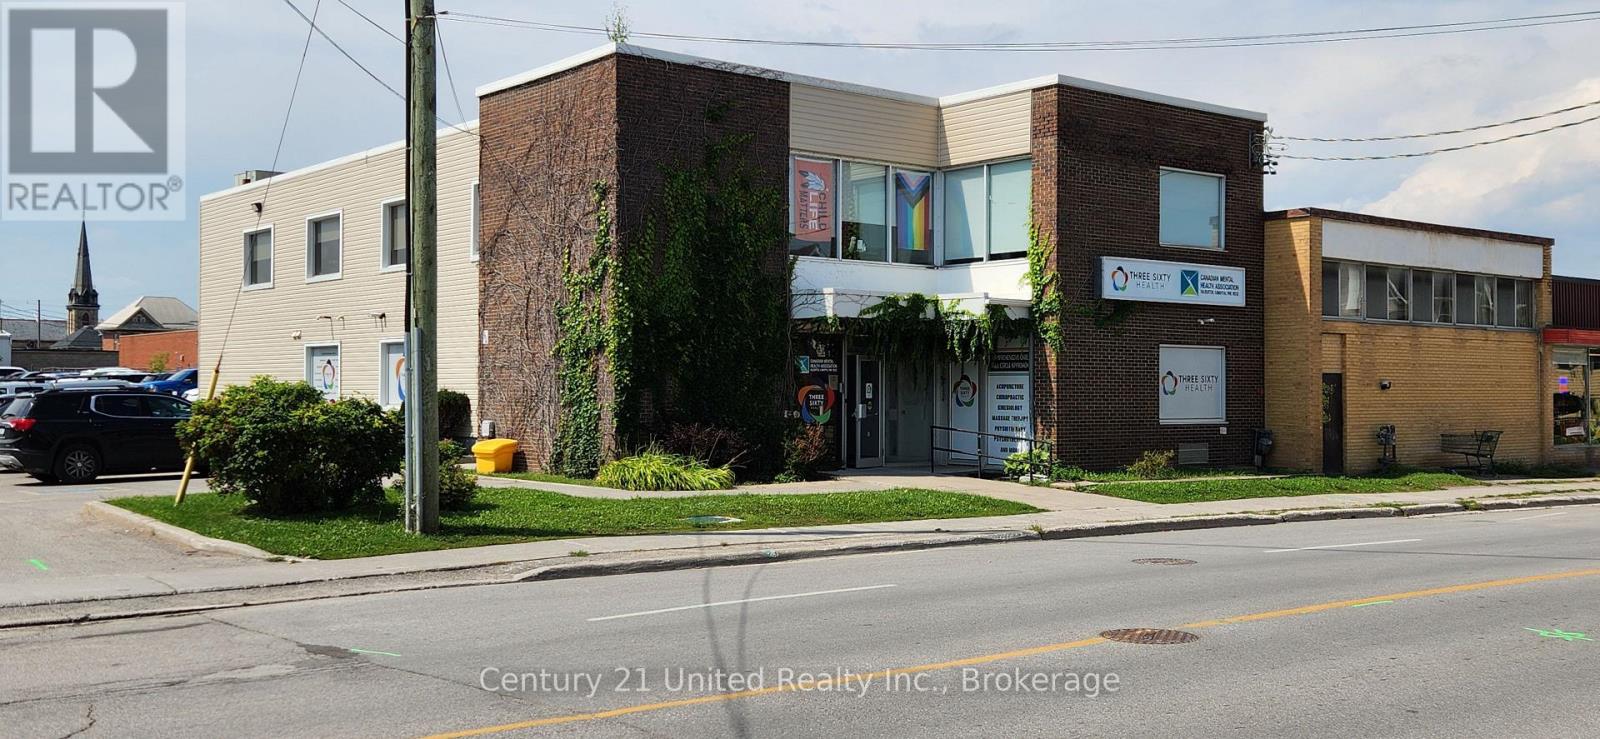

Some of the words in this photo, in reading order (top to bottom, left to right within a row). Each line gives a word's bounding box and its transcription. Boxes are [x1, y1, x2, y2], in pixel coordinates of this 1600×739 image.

[799, 191, 809, 229] MATTERS
[809, 192, 818, 230] LIFE
[818, 192, 828, 230] CHILD
[1130, 271, 1150, 280] THREE
[1153, 272, 1172, 281] SIXTY
[1179, 375, 1198, 383] THREE
[1200, 375, 1218, 383] SIXTY
[1185, 384, 1212, 392] HEALTH
